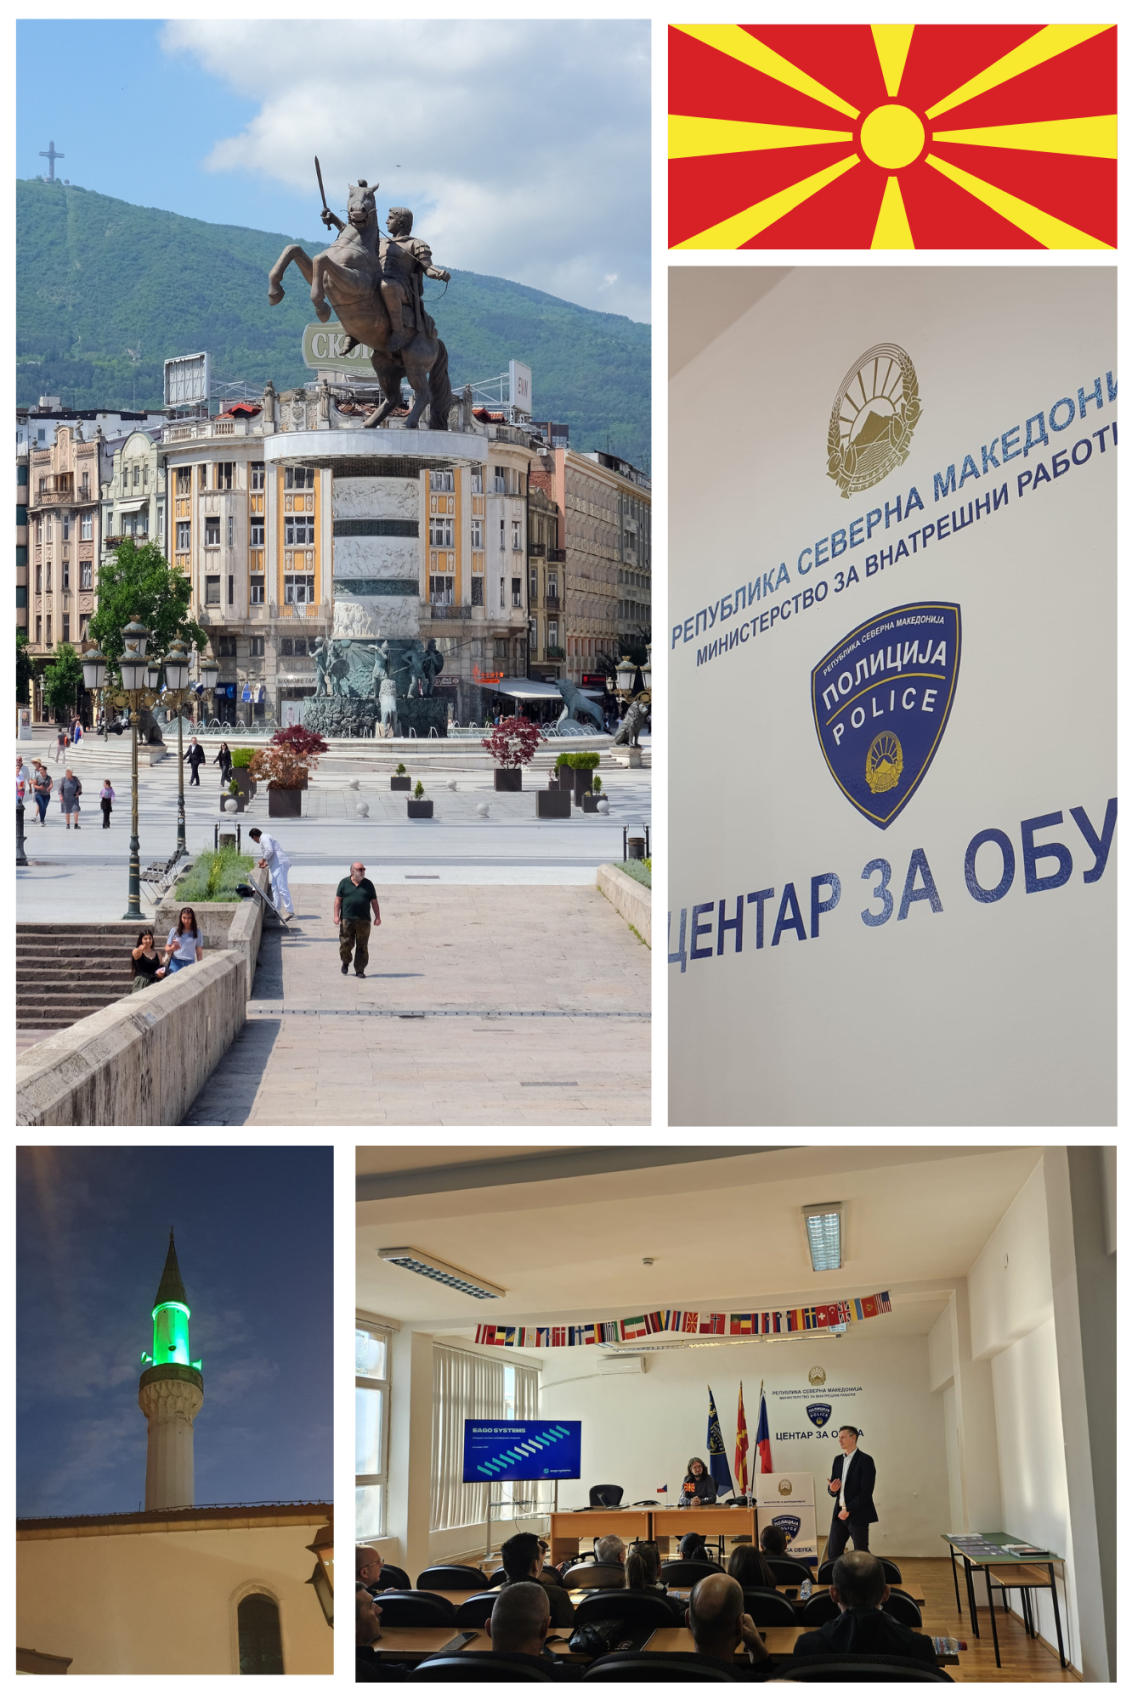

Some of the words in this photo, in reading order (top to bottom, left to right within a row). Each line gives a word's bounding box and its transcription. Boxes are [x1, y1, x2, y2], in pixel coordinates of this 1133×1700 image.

[311, 333, 370, 359] СКО
[518, 377, 529, 398] EVN
[670, 562, 791, 650] РЕПУБЛИКА
[797, 486, 925, 576] СЕВЕРНА
[696, 580, 829, 667] МИНИСТЕРСТВО
[833, 565, 860, 594] ЗА
[866, 482, 1009, 579] ВНАТРЕШНИ
[1018, 421, 1118, 498] РАБОТ
[822, 639, 947, 711] ПОЛИЦИЈА
[823, 640, 861, 676] РЕПУБЛИКА
[861, 621, 895, 643] СЕВЕРНА
[896, 615, 945, 627] МАКЕДОНИЈА
[832, 687, 938, 746] POLICE
[668, 872, 842, 973] ЦЕНТАР
[860, 847, 944, 927] ЗА
[963, 797, 1118, 904] ОБУ
[775, 1431, 814, 1441] ЦЕНТАР
[816, 1430, 829, 1439] ЗА
